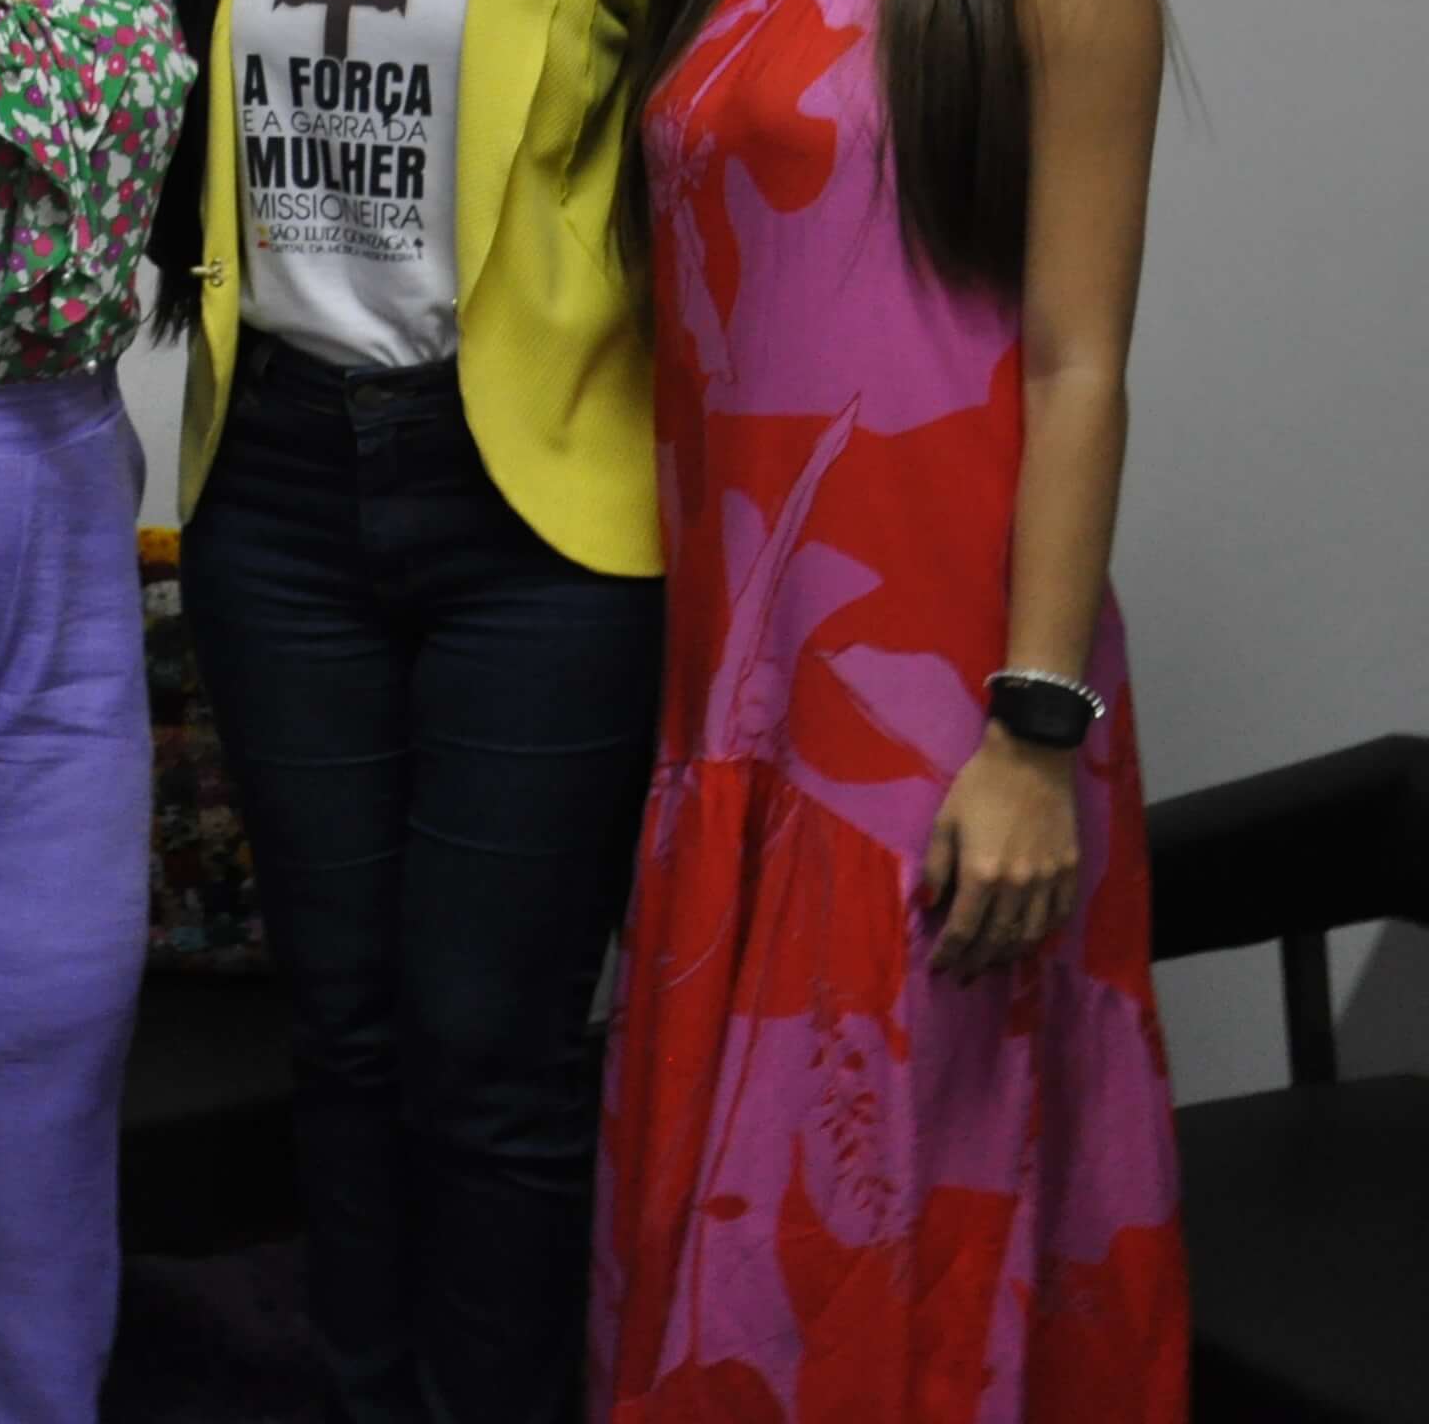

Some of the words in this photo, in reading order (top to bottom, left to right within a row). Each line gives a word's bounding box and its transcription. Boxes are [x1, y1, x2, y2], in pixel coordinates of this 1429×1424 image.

[243, 53, 268, 106] A
[289, 57, 432, 127] FORÇA
[243, 109, 254, 133] E
[262, 109, 282, 133] A
[291, 110, 378, 141] GARRA
[387, 118, 428, 143] DA
[245, 135, 427, 199] MULHER
[249, 192, 424, 230] MISSIONEIRA
